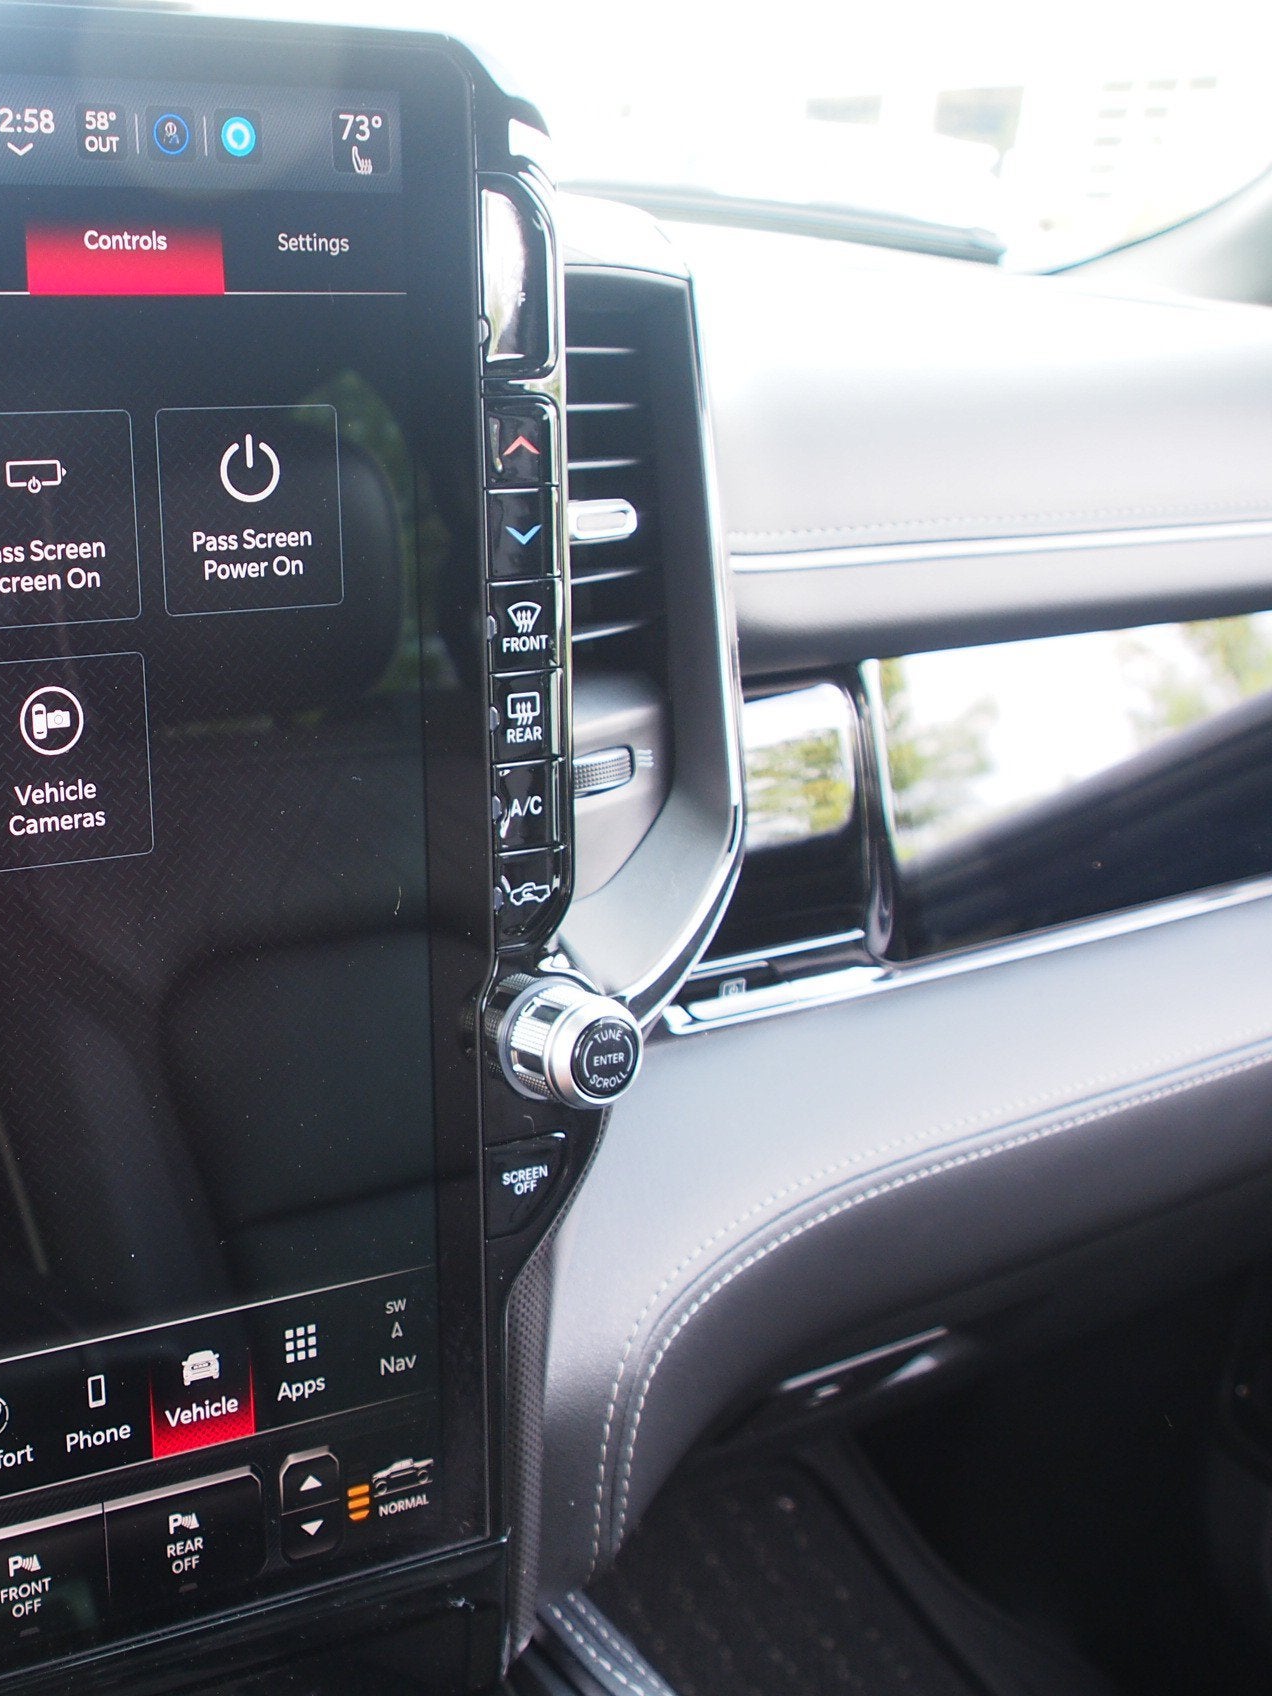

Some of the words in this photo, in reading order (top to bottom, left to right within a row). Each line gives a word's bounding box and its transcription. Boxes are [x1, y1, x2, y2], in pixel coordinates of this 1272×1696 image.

[84, 135, 120, 153] OUT
[84, 230, 167, 252] Controls
[278, 232, 350, 256] Settings
[29, 539, 106, 562] Screen
[192, 531, 239, 553] Pass
[242, 528, 312, 550] Screen
[66, 567, 101, 589] On
[204, 559, 268, 581] Power
[272, 556, 304, 577] On
[502, 634, 549, 653] FRONT
[506, 725, 543, 744] REAR
[13, 778, 97, 806] Vehicle
[511, 795, 543, 816] A/C
[9, 810, 106, 836] Cameras
[593, 1028, 624, 1043] TUNE
[593, 1051, 625, 1067] ENTER
[590, 1072, 627, 1089] SCROLL
[502, 1165, 548, 1184] SCREEN
[514, 1180, 537, 1195] OFF
[385, 1298, 407, 1315] SW
[380, 1354, 417, 1376] Nav
[277, 1377, 326, 1402] Apps
[165, 1396, 238, 1427] Vehicle
[66, 1424, 131, 1453] Phone
[378, 1493, 429, 1517] NORMAL
[166, 1535, 204, 1559] REAR
[172, 1552, 200, 1574] OFF
[0, 1577, 52, 1604] FRONT
[12, 1597, 41, 1618] OFF
